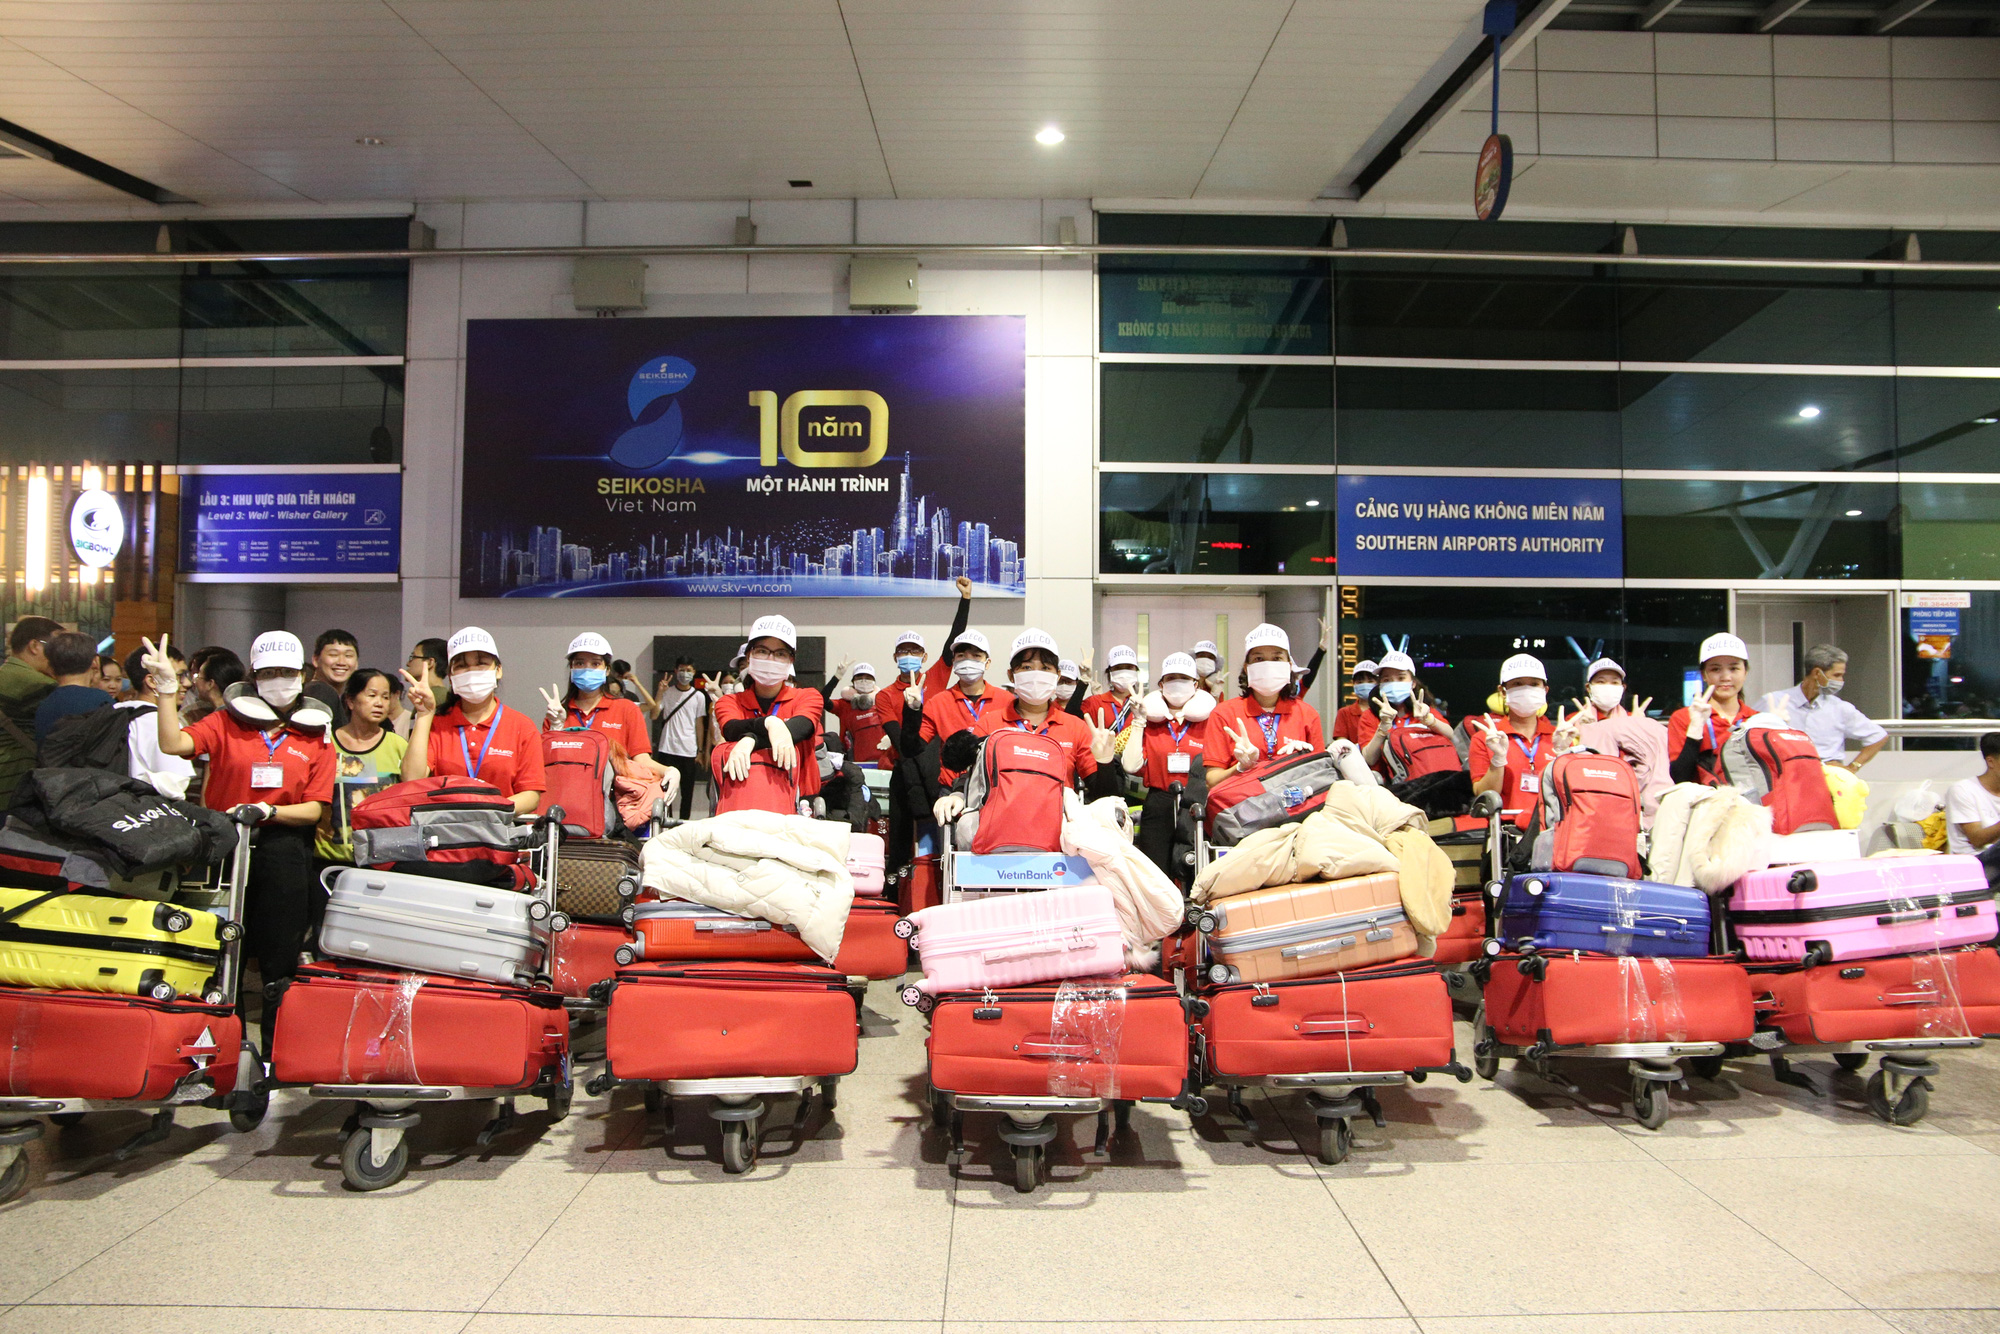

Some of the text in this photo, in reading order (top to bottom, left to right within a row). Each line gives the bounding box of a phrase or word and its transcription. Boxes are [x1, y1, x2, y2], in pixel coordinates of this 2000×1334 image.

[748, 390, 889, 468] 10
[807, 416, 863, 438] năm
[597, 477, 706, 495] SEIKOSHA
[746, 474, 889, 496] MỘT HÀNH TRÌNH
[220, 494, 230, 506] 3:
[232, 494, 253, 506] KHU
[322, 491, 356, 505] KHÁCH
[605, 497, 697, 513] Viet Nam
[207, 511, 234, 520] Level
[235, 511, 245, 520] 3:
[248, 511, 269, 520] Well
[277, 510, 311, 520] Wisher
[313, 510, 348, 521] Gallery
[1355, 497, 1399, 519] CẢNG
[1403, 503, 1424, 521] VỤ
[1427, 500, 1470, 520] HÀNG
[1474, 501, 1528, 520] KHÔNG
[1572, 506, 1605, 521] NAM
[1355, 534, 1605, 553] SOUTHERN AIRPORTS AUTHORITY
[687, 581, 792, 594] www.skv-vn.com
[757, 621, 792, 636] SULECO
[258, 641, 297, 653] SULECO
[453, 634, 489, 648] SULECO
[1113, 649, 1136, 659] SULECO
[1165, 658, 1193, 668] SULECO
[997, 869, 1053, 880] VietinBank
